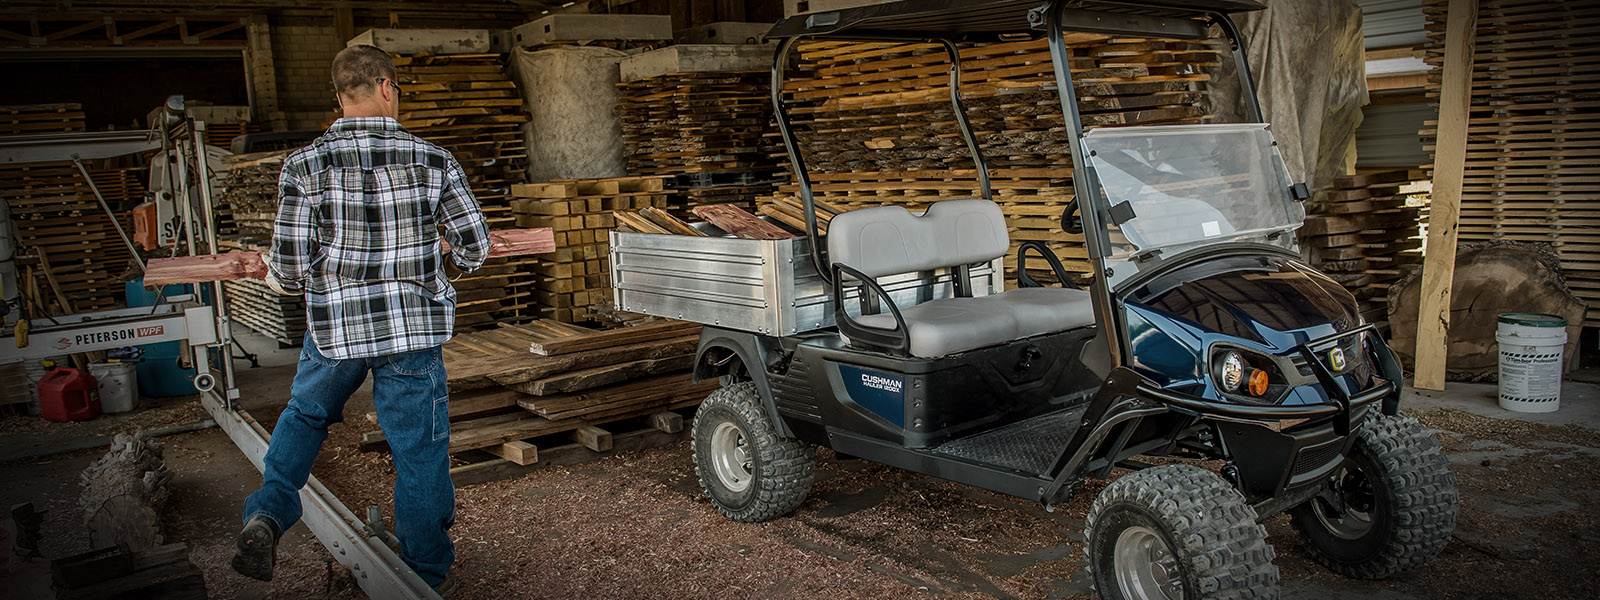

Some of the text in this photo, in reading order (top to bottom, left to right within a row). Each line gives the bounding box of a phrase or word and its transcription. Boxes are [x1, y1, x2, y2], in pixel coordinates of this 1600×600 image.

[75, 326, 162, 345] PETERSON WPF
[861, 373, 902, 388] CUSHMAN
[863, 381, 883, 389] HAULER
